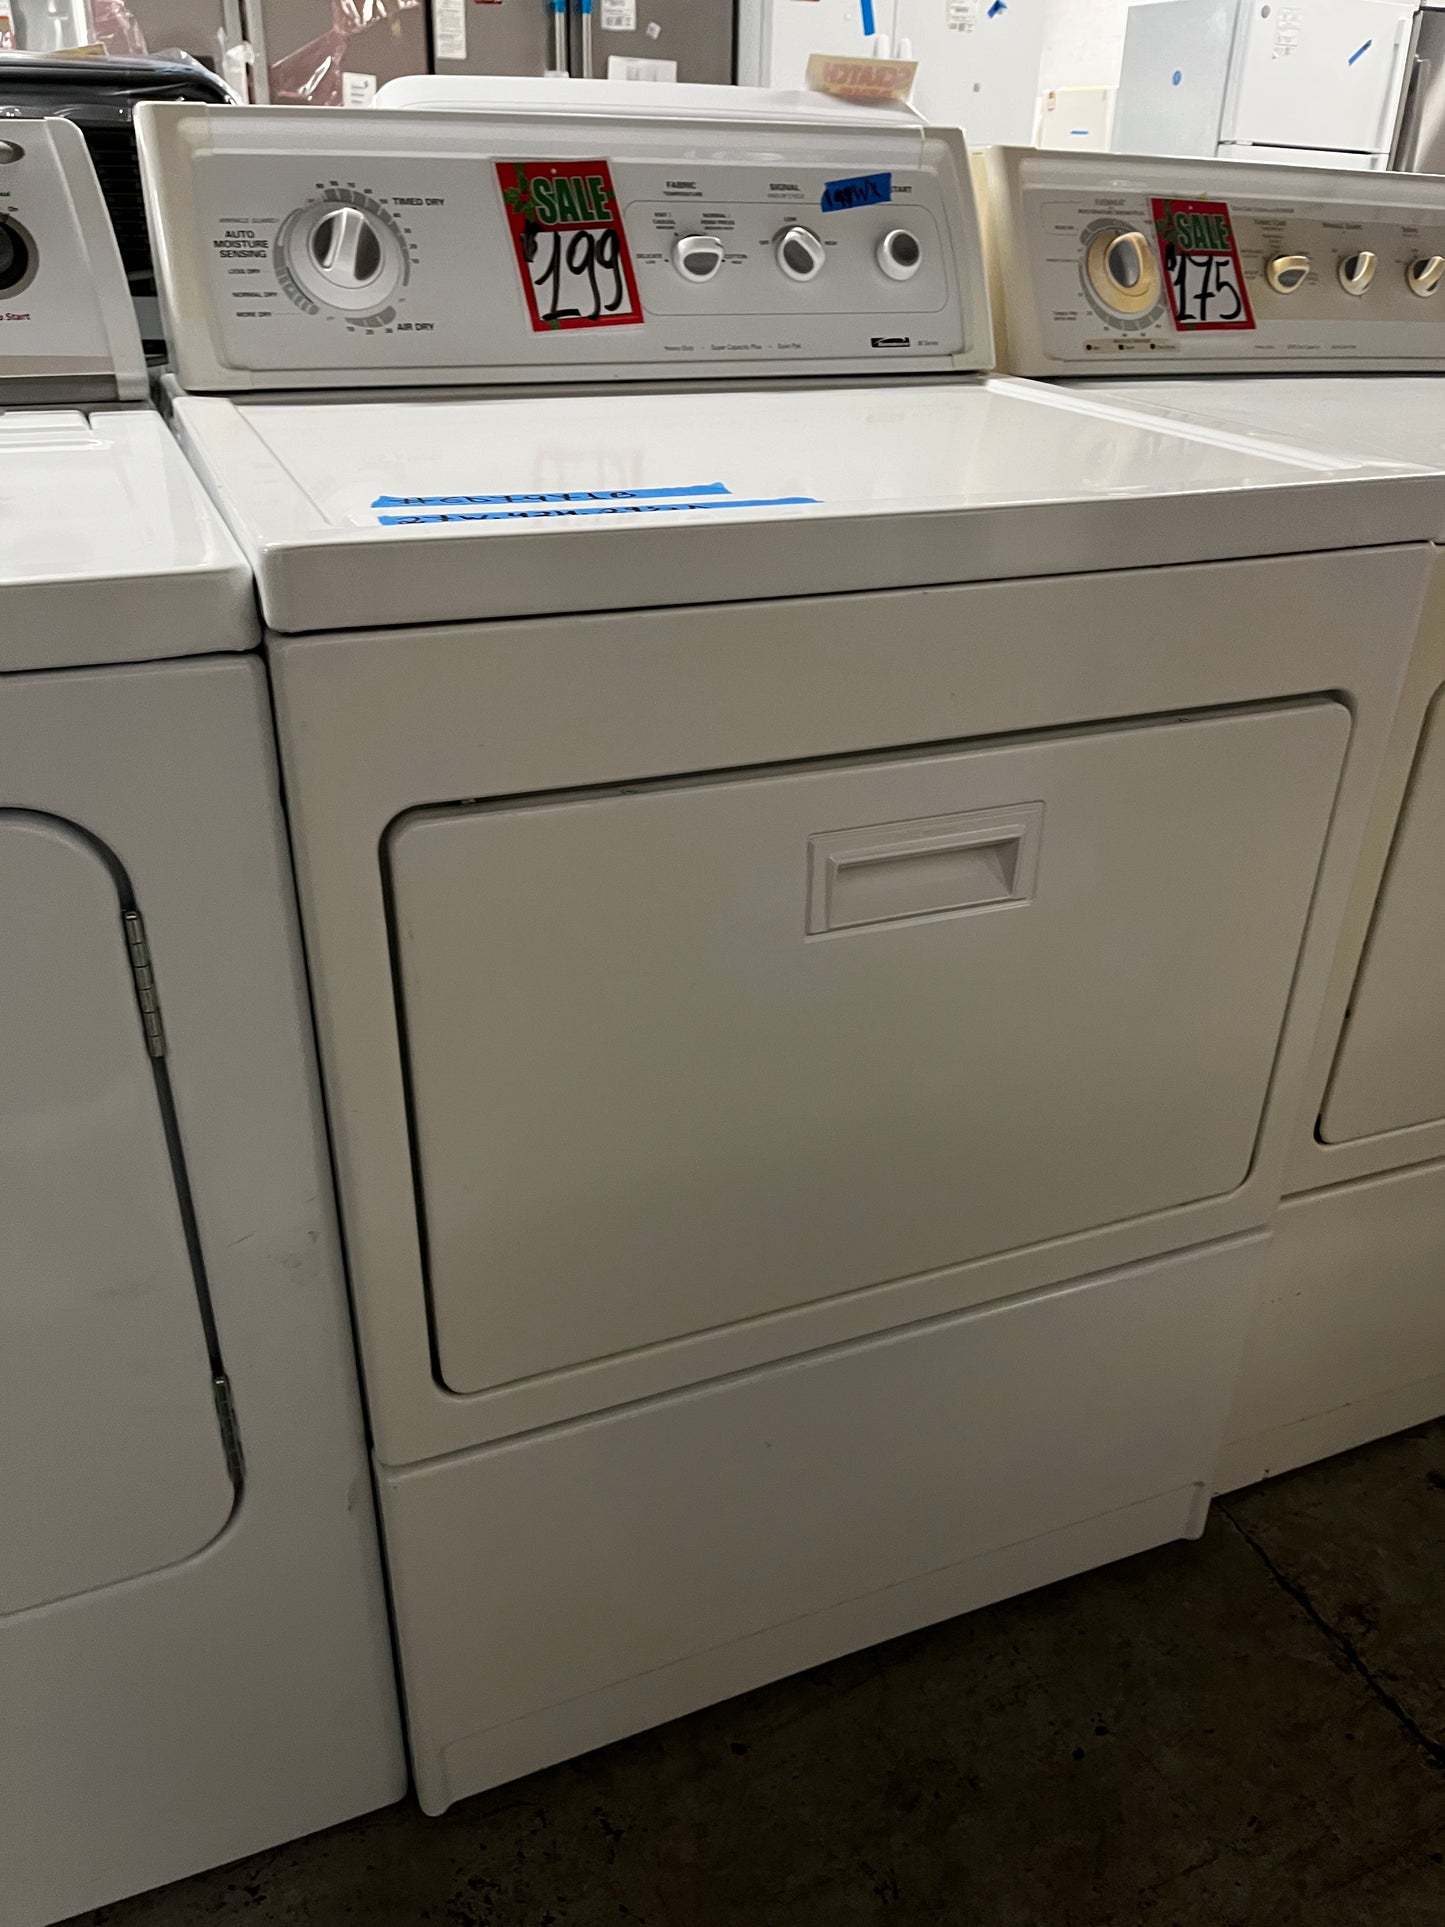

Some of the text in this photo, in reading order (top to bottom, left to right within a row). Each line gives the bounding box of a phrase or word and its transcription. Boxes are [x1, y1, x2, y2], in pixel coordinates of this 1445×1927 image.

[666, 181, 696, 189] FABRIC
[392, 197, 445, 206] TIMED DRY
[531, 176, 614, 225] SALE
[225, 230, 255, 238] AUTO
[1174, 212, 1232, 251] SALE
[213, 240, 269, 248] MOISTURE
[219, 250, 267, 258] SENSING
[5, 312, 31, 320] Start
[397, 323, 435, 331] AIR DRY
